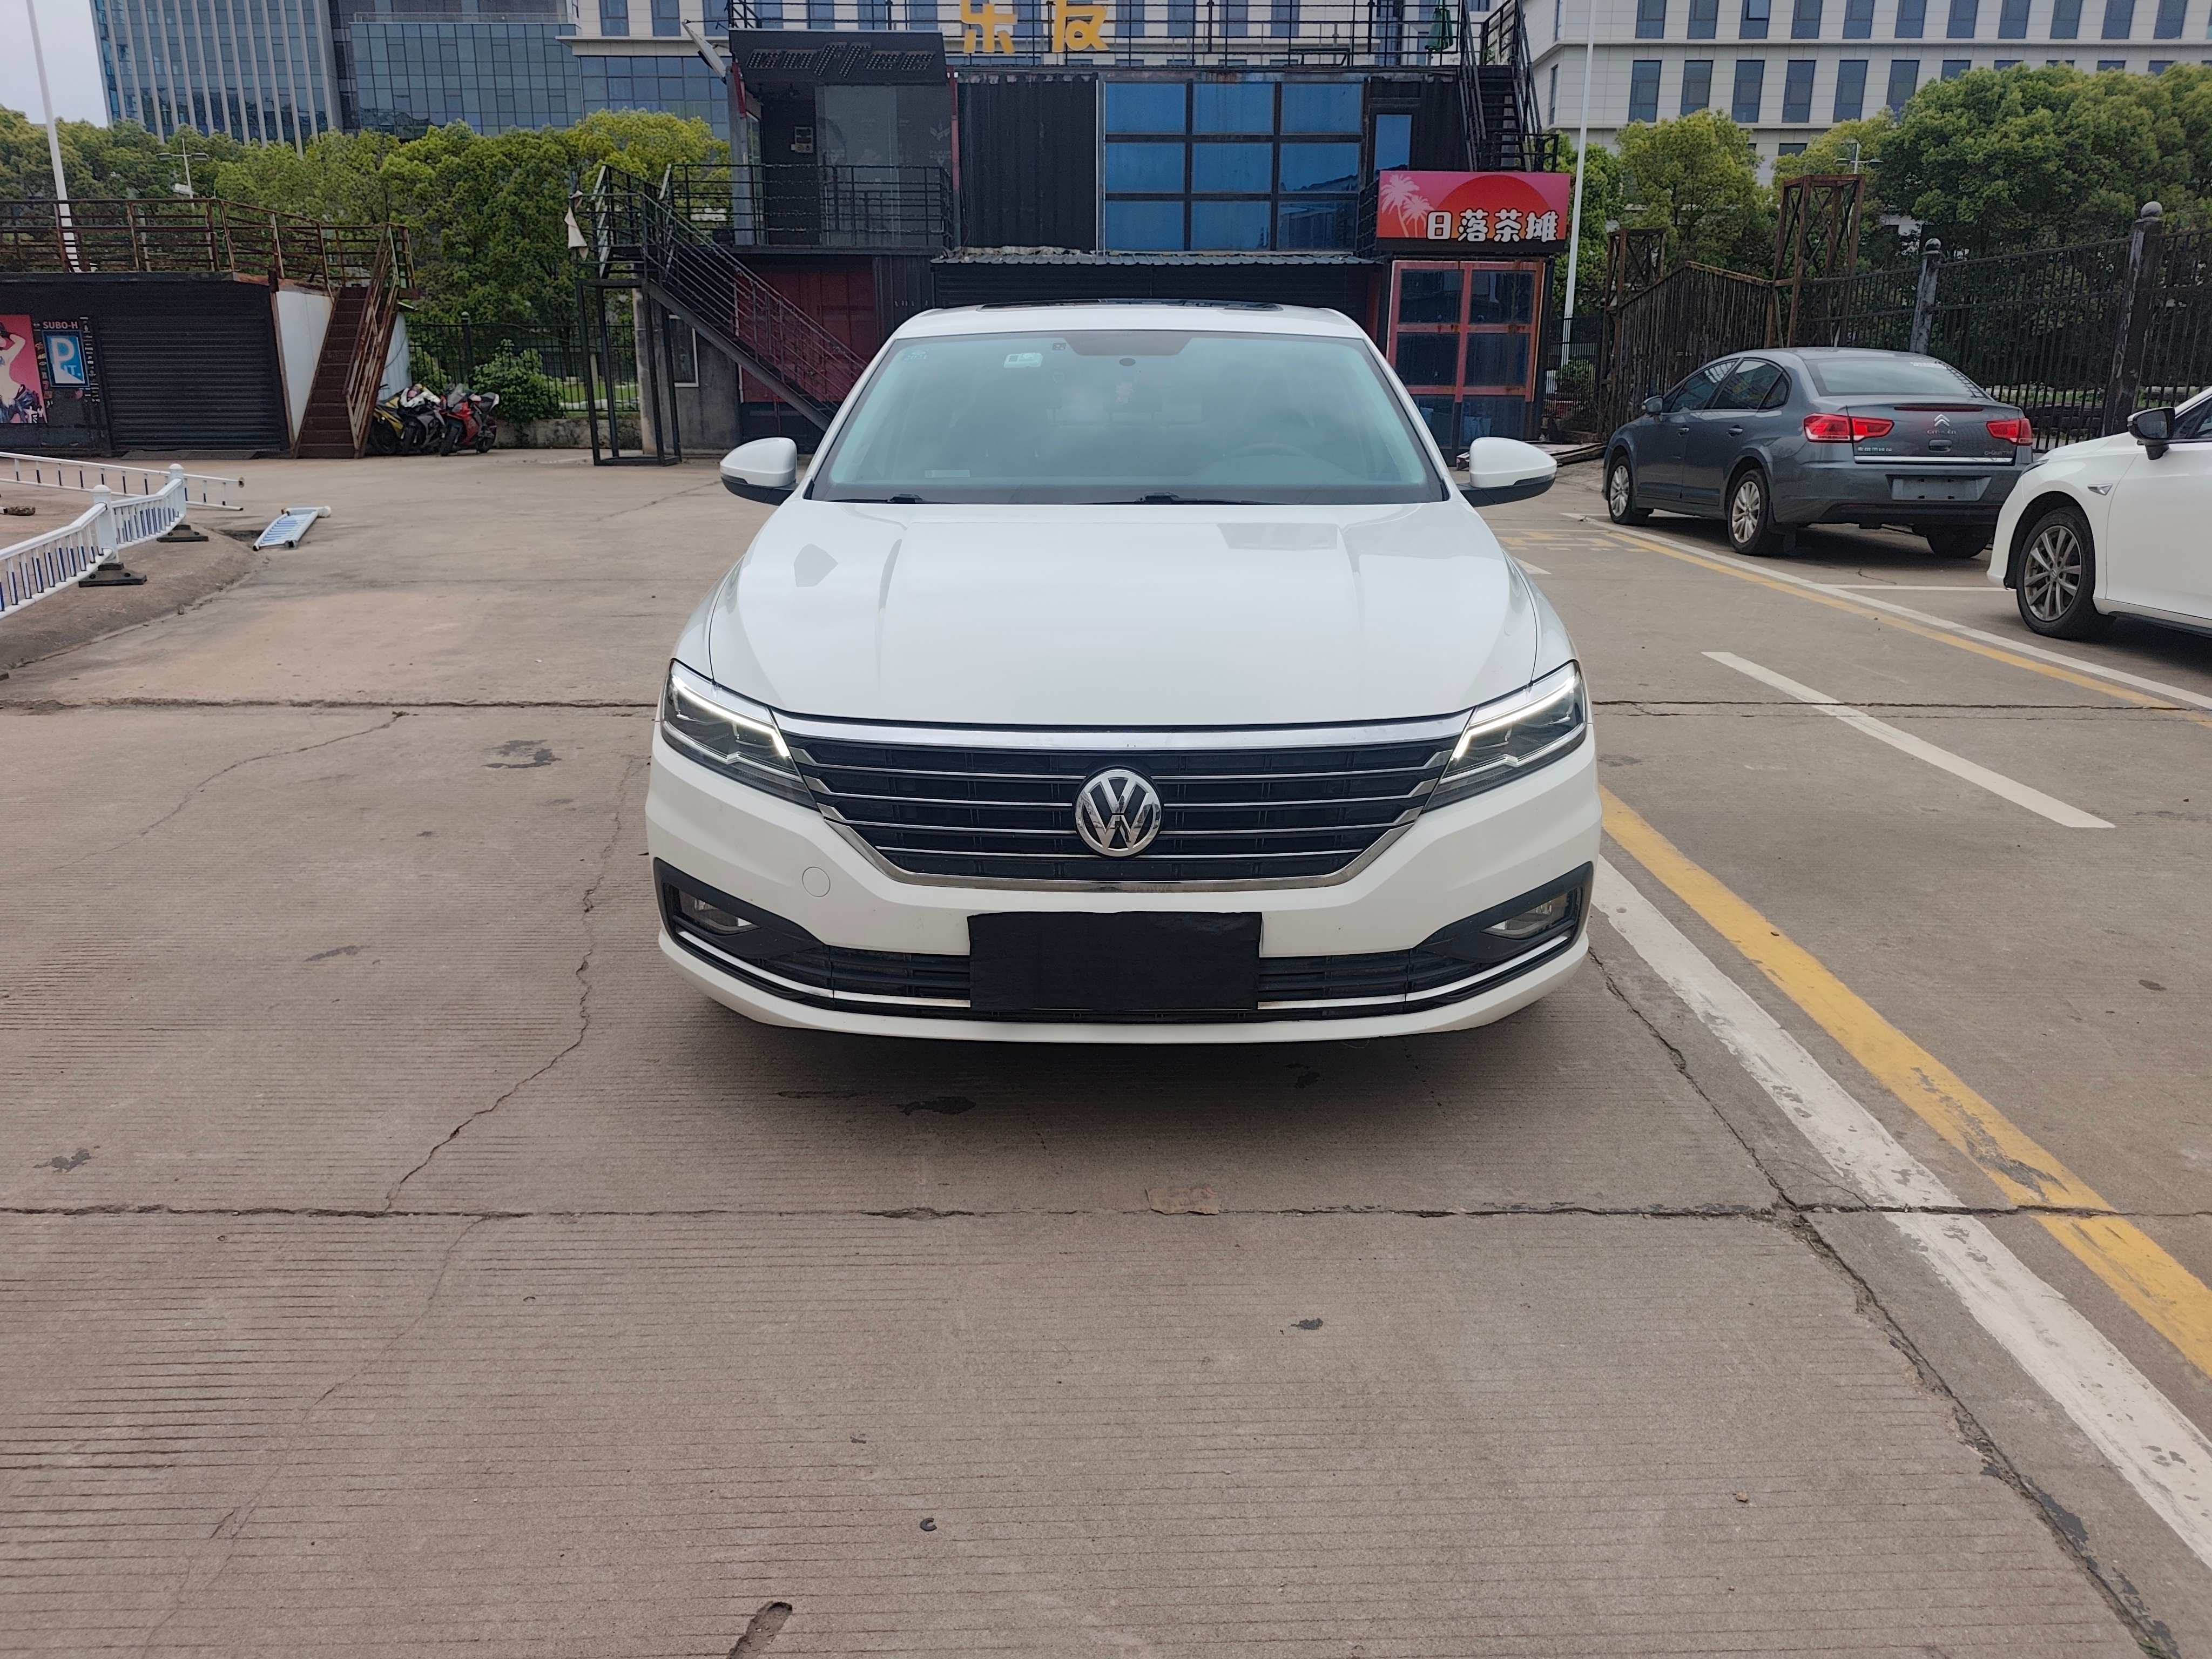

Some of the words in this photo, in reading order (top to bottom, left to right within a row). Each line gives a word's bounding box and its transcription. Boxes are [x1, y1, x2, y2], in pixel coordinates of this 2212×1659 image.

[1427, 208, 1559, 242] 日落茶摊
[43, 321, 79, 330] SUBO-H
